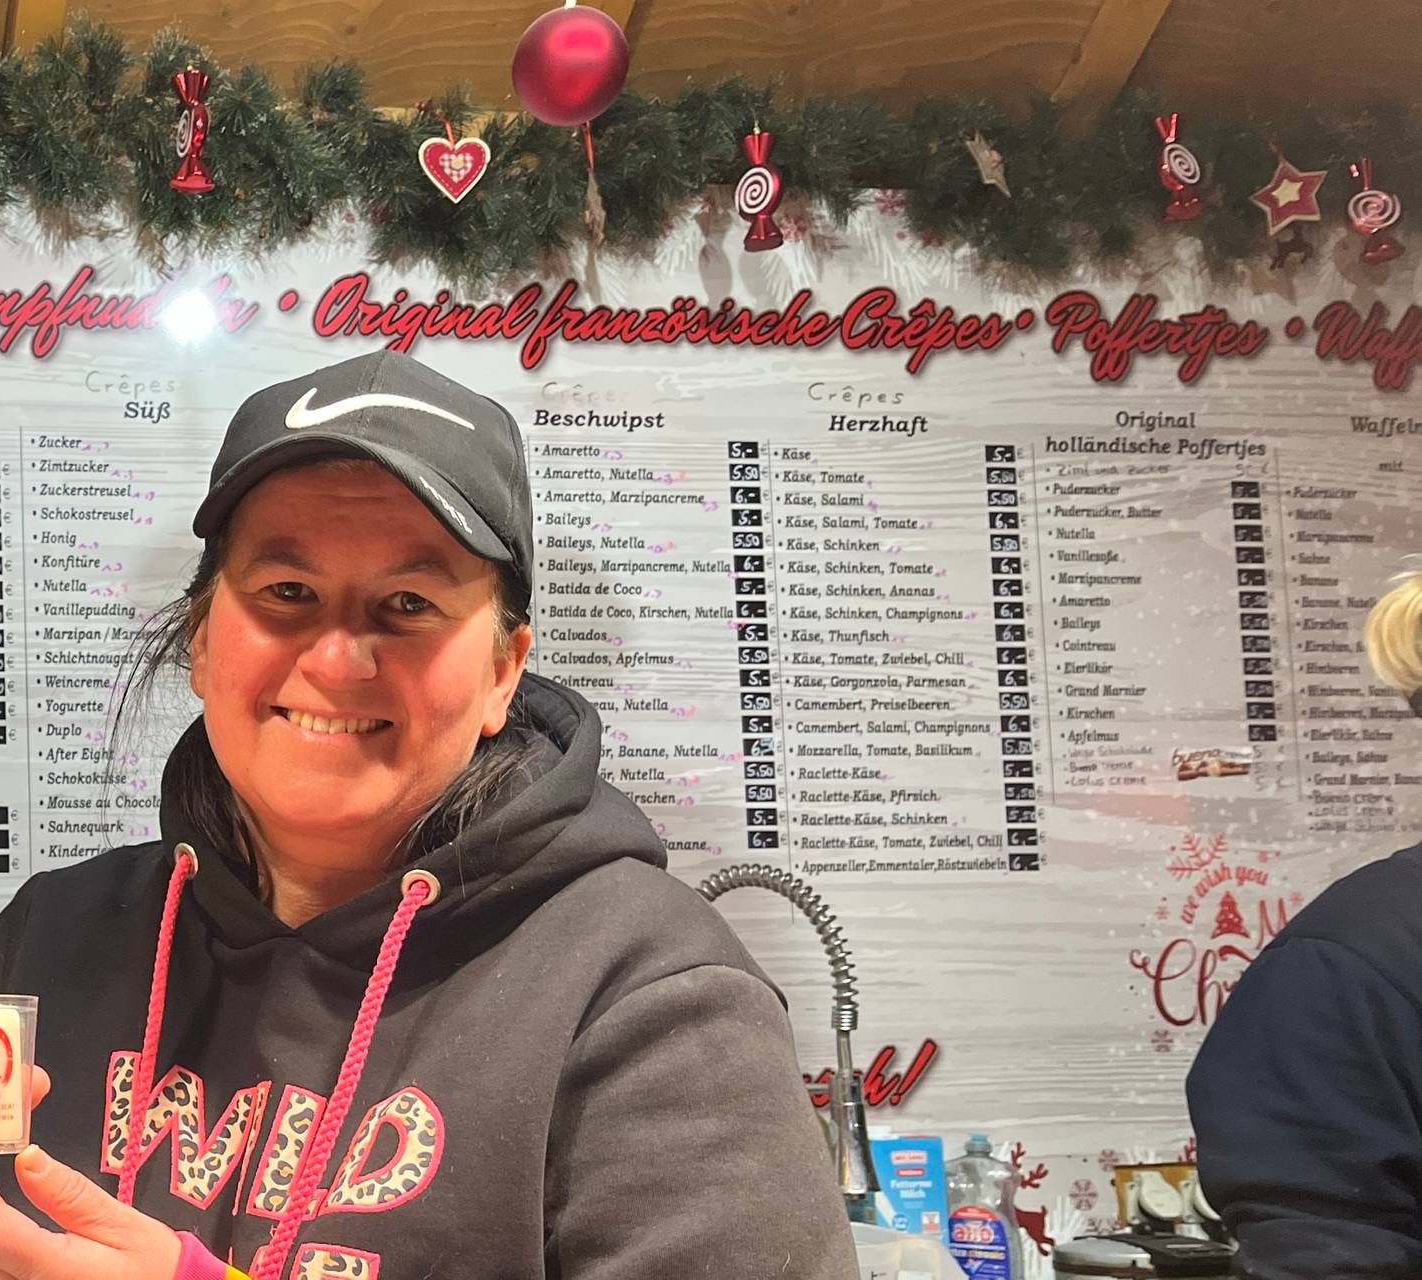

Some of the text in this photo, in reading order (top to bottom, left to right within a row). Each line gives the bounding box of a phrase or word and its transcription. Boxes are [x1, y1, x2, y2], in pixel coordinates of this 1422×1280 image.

[312, 273, 842, 370] Original französische
[839, 287, 1012, 375] Crêpes
[1046, 290, 1270, 383] Poffertjes
[85, 371, 175, 400] Crêpes
[808, 382, 904, 408] Crêpes
[124, 402, 170, 423] Süß
[534, 410, 664, 432] Beschwipst
[829, 415, 928, 437] Herzhaft
[1116, 411, 1196, 429] Original
[39, 436, 82, 448] Zucker
[1046, 437, 1266, 460] holländische Poffertjes
[542, 446, 600, 457] Amaretto
[781, 449, 811, 460] Käse
[39, 460, 109, 473] Zimtzucker
[543, 468, 653, 481] Amaretto, Nutella
[783, 472, 865, 484] Käse, Tomate
[40, 484, 131, 497] Zuckerstreusel
[40, 508, 134, 521] Schokostreusel
[545, 514, 591, 528] Baileys
[41, 532, 76, 546] Honig
[1056, 529, 1096, 540] Nutella
[42, 556, 100, 570] Konfitüre
[42, 581, 87, 592] Nutella
[548, 583, 642, 595] Batida de Coco
[789, 586, 935, 598] Käse, Schinken, Ananas
[1059, 596, 1110, 607] Amaretto
[43, 605, 136, 621] Vanillepudding
[549, 607, 733, 619] Batida de Coco, Kirschen, Nutella
[1061, 618, 1101, 632] Baileys
[791, 631, 889, 645] Käse, Thunfisch
[1063, 640, 1116, 652] Cointreau
[551, 653, 674, 666] Calvados, Apfelmus
[792, 654, 825, 666] Käse,
[830, 655, 878, 667] Tomate,
[935, 654, 964, 665] Chili
[45, 677, 110, 688] Weincreme
[1065, 685, 1103, 697] Grand
[45, 701, 104, 714] Yogurette
[795, 700, 950, 712] Camembert, Preiselbeeren
[1067, 708, 1115, 720] Kirschen
[46, 724, 82, 737] Duplo
[1068, 730, 1120, 743] Apfelmus
[46, 749, 114, 763] After Eight
[799, 768, 881, 779] Raclette-Käse
[48, 821, 124, 834] Sahnequark
[1195, 863, 1232, 898] wish
[1235, 866, 1268, 886] you
